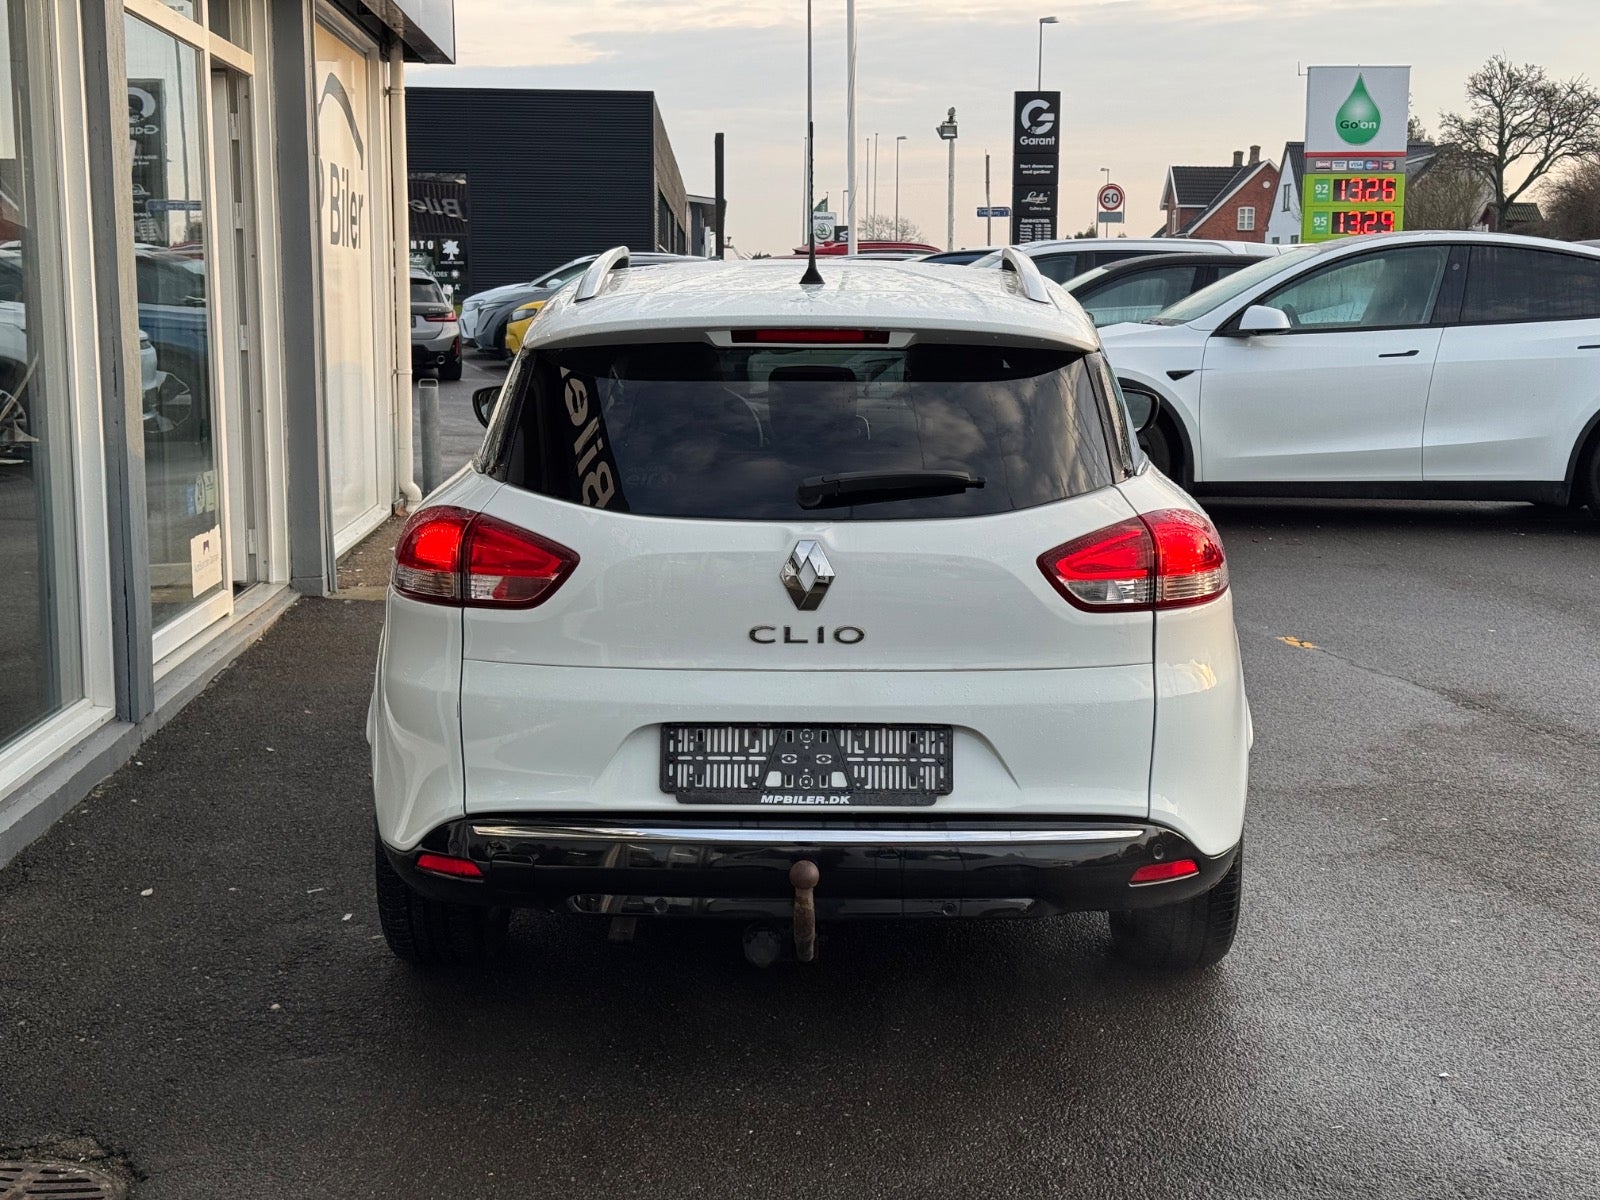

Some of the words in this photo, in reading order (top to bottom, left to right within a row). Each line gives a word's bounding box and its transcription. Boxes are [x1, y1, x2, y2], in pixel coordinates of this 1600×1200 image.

[1340, 120, 1377, 129] Go'on
[1020, 136, 1055, 145] Garant
[1315, 184, 1329, 194] 92
[1341, 177, 1396, 203] 13.26
[1103, 193, 1119, 204] 60
[330, 162, 364, 250] Biler
[1313, 217, 1328, 226] 95
[749, 625, 865, 644] CLIO
[760, 795, 851, 805] MPBILER.DK
